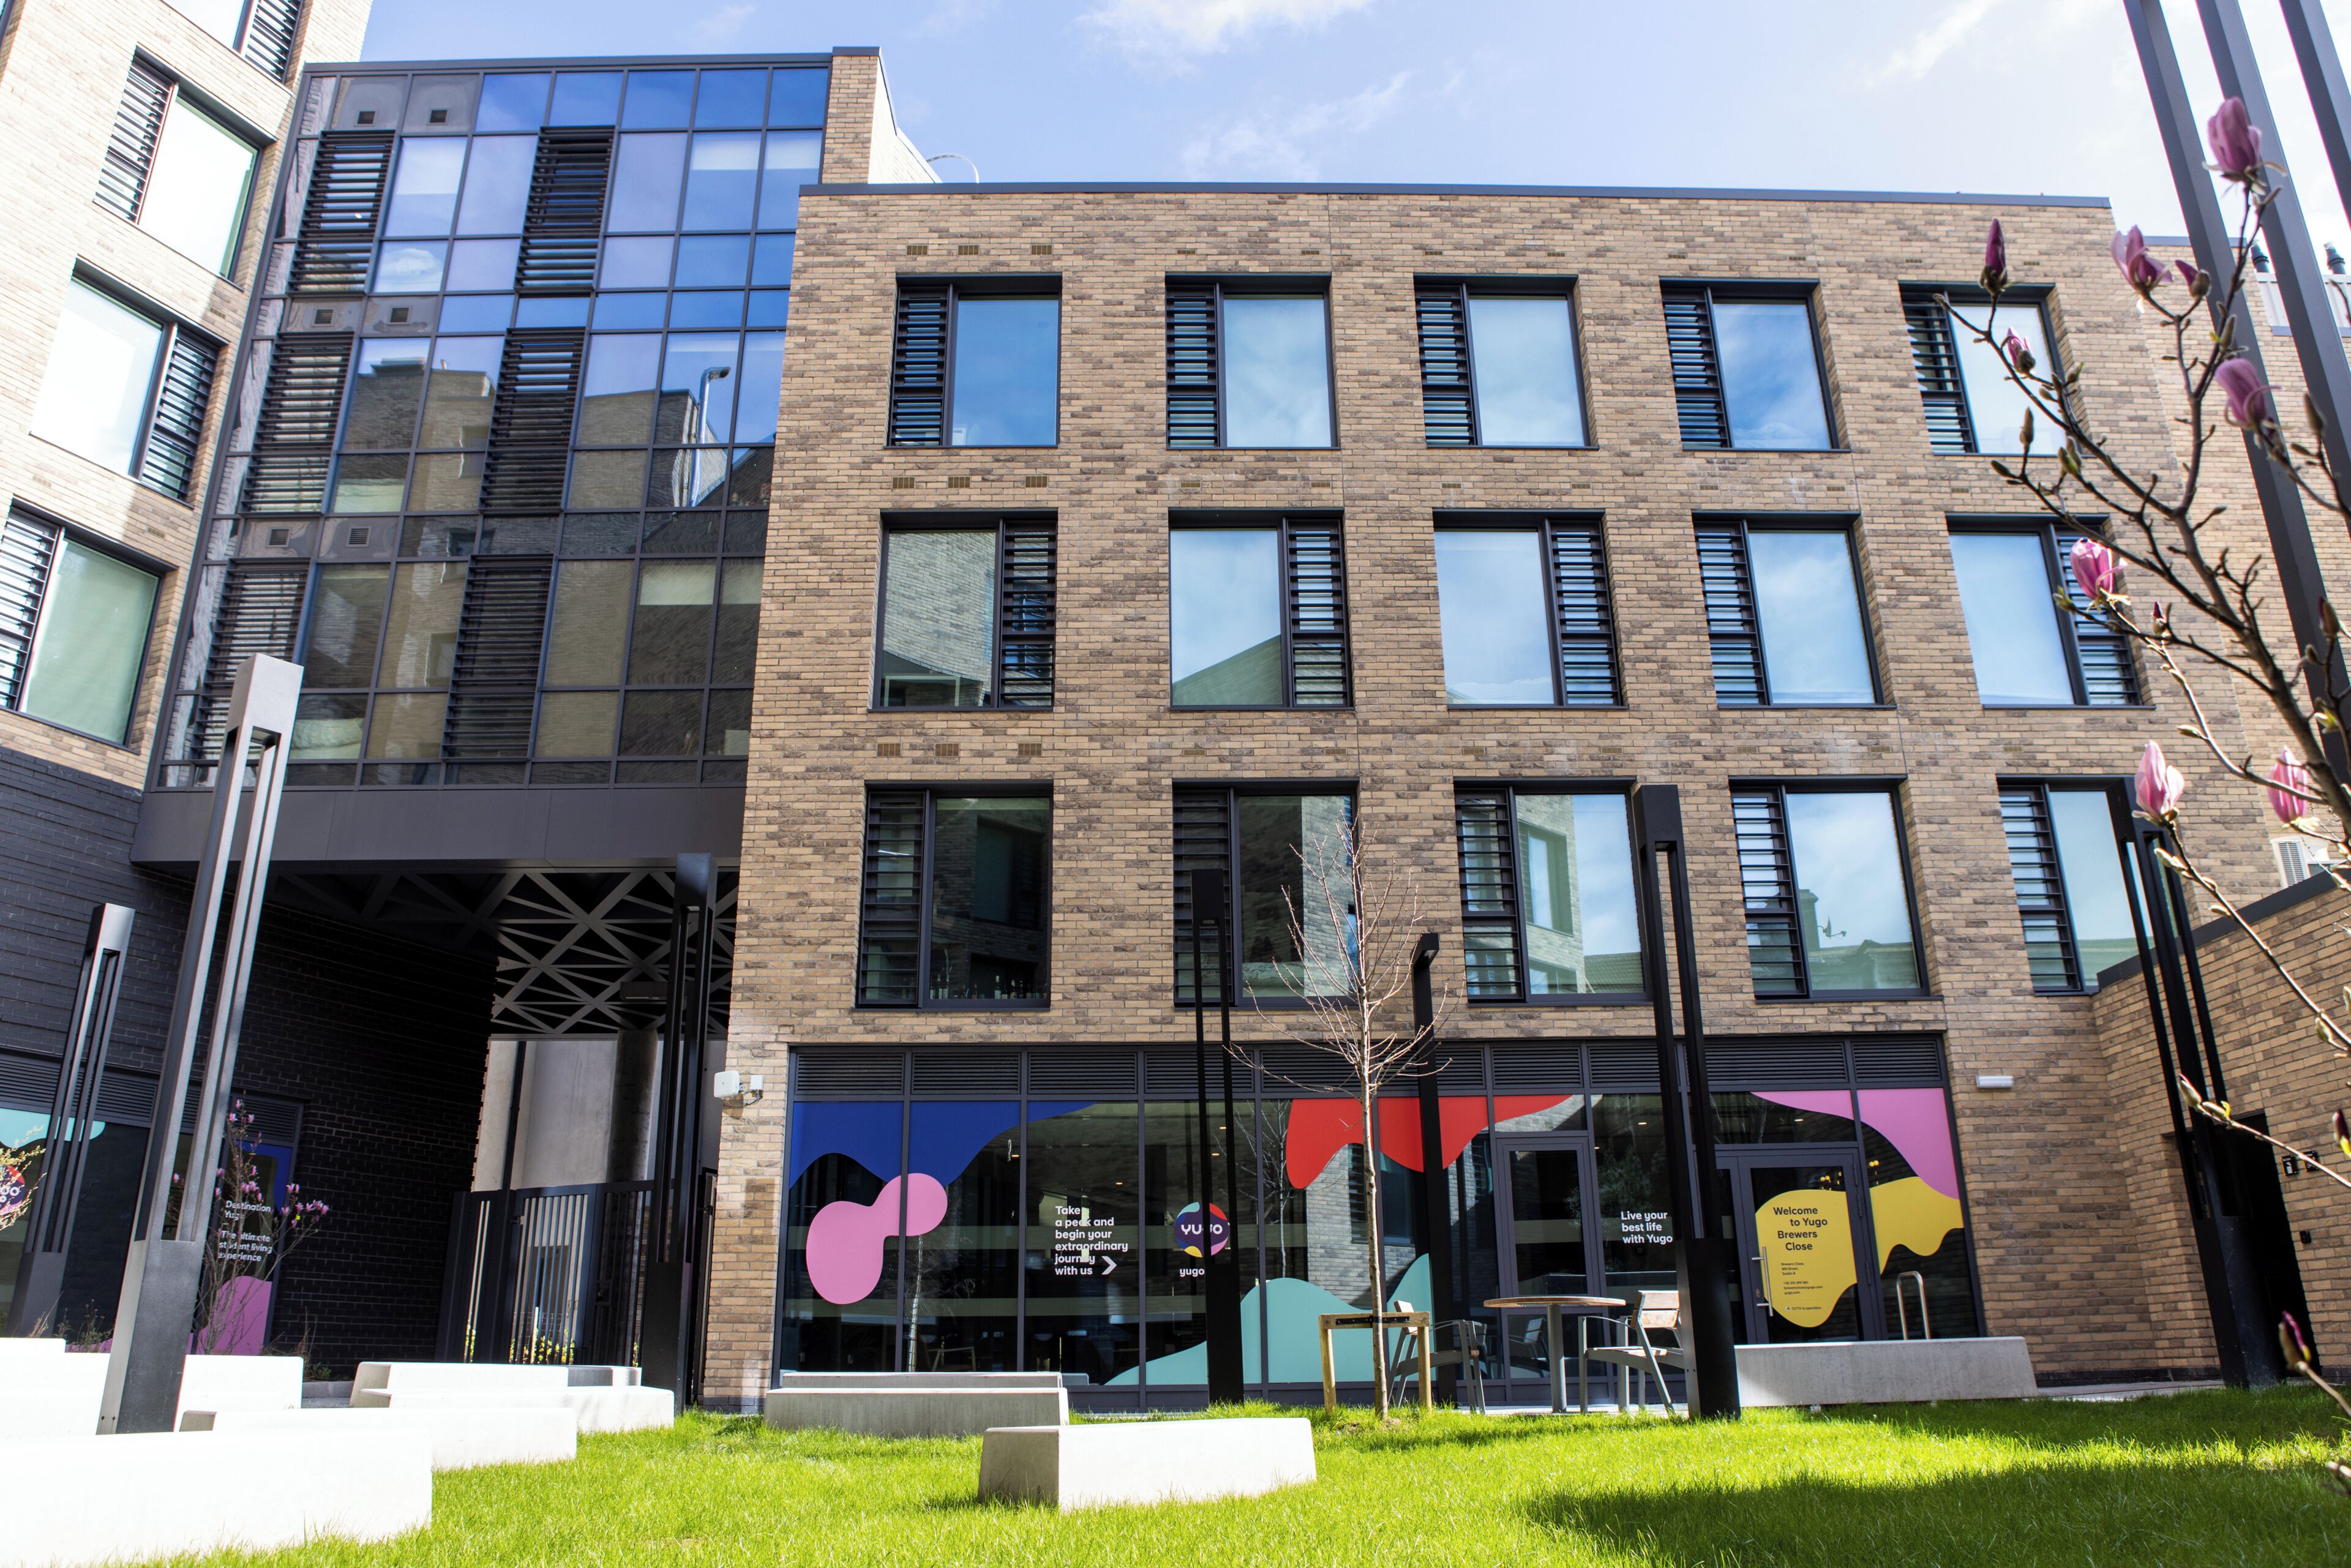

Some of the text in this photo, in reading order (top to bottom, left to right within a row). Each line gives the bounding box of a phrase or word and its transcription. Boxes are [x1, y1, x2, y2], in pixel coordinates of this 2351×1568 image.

[225, 1200, 271, 1212] Destination
[1055, 1206, 1081, 1215] Take
[1773, 1206, 1818, 1215] Welcome
[225, 1210, 245, 1220] Yug
[1621, 1211, 1668, 1221] Live your
[1065, 1218, 1091, 1229] peek
[1093, 1217, 1114, 1226] and
[1621, 1222, 1662, 1232] best life
[1802, 1218, 1828, 1228] Yugo
[1055, 1229, 1112, 1240] begin your
[1181, 1224, 1223, 1235] YUO
[1777, 1230, 1818, 1239] Brewers
[1622, 1234, 1673, 1245] with Yugo
[251, 1243, 272, 1254] living
[1055, 1241, 1128, 1252] extraordinary
[1785, 1242, 1813, 1251] Close
[218, 1252, 261, 1261] experience
[1055, 1266, 1078, 1275] with
